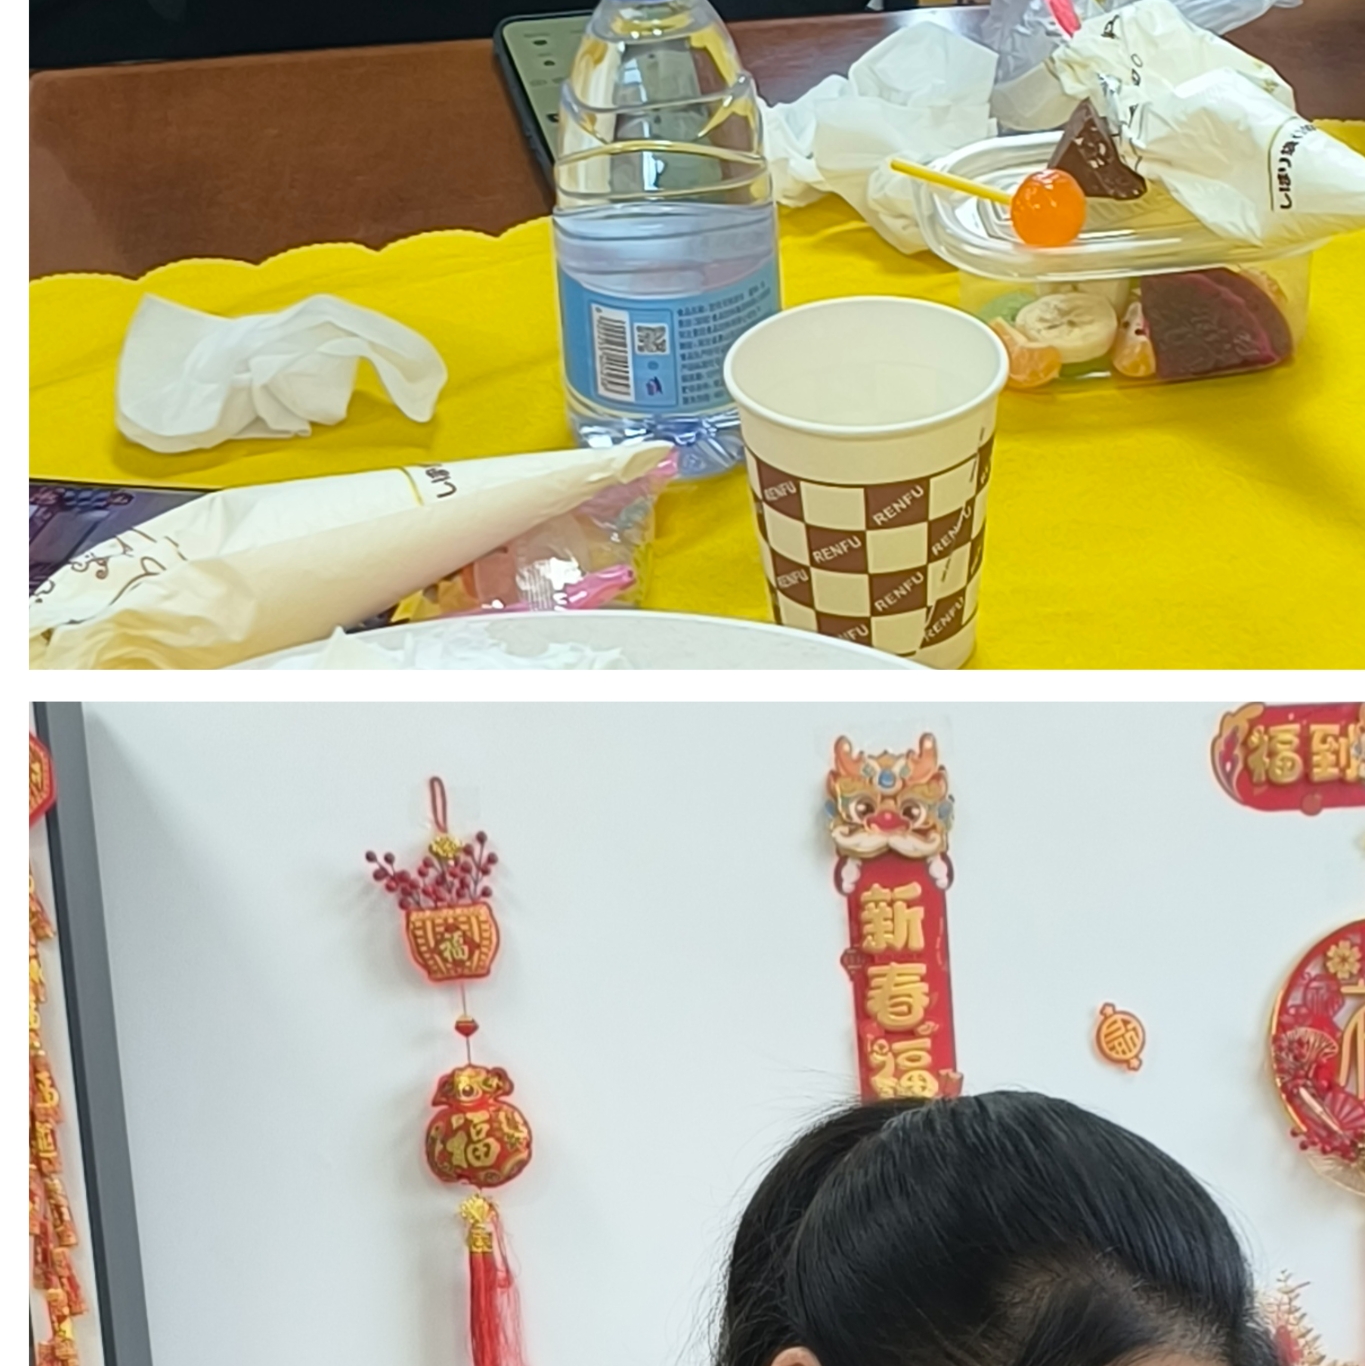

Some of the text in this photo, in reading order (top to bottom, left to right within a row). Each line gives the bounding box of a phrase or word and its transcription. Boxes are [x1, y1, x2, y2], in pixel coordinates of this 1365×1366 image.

[764, 480, 797, 503] RENFU
[872, 484, 924, 527] RENFU
[812, 535, 862, 564] RENFU
[874, 572, 925, 612] RENFU
[924, 596, 965, 641] RENFU
[445, 1109, 501, 1170] 福
